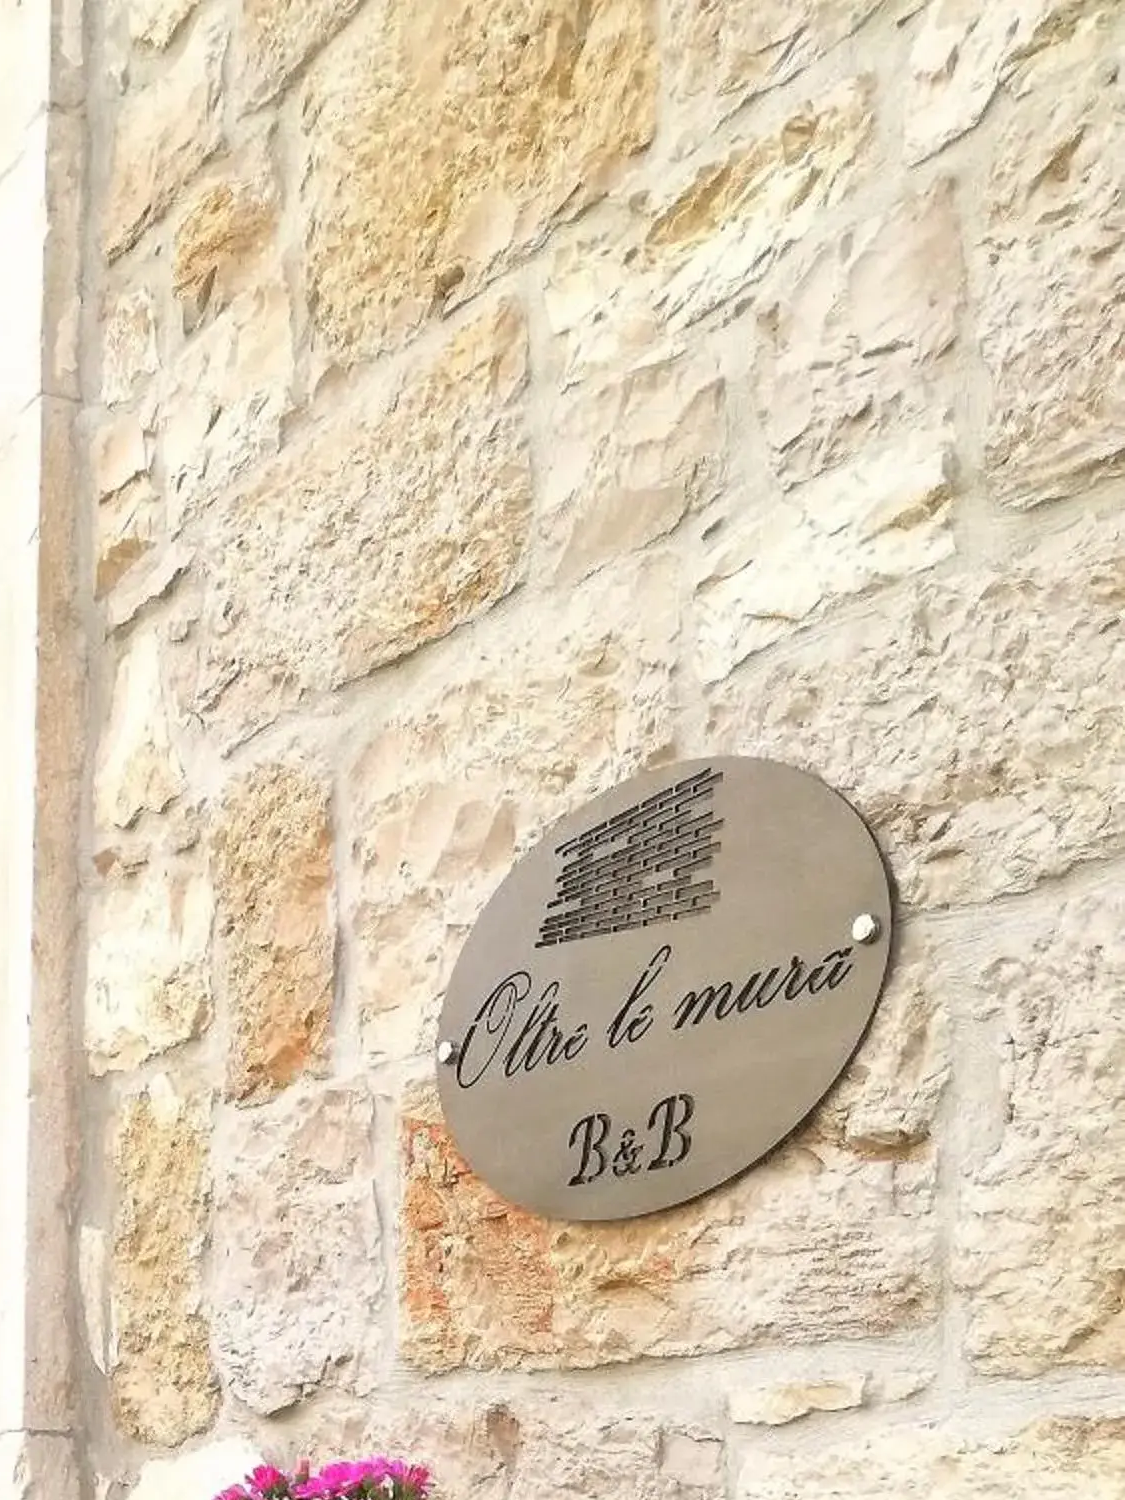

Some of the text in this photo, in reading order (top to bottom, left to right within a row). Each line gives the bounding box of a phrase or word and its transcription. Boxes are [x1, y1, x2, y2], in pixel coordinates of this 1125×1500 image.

[456, 944, 854, 1089] Oltre le mura
[567, 1093, 695, 1187] B&B
